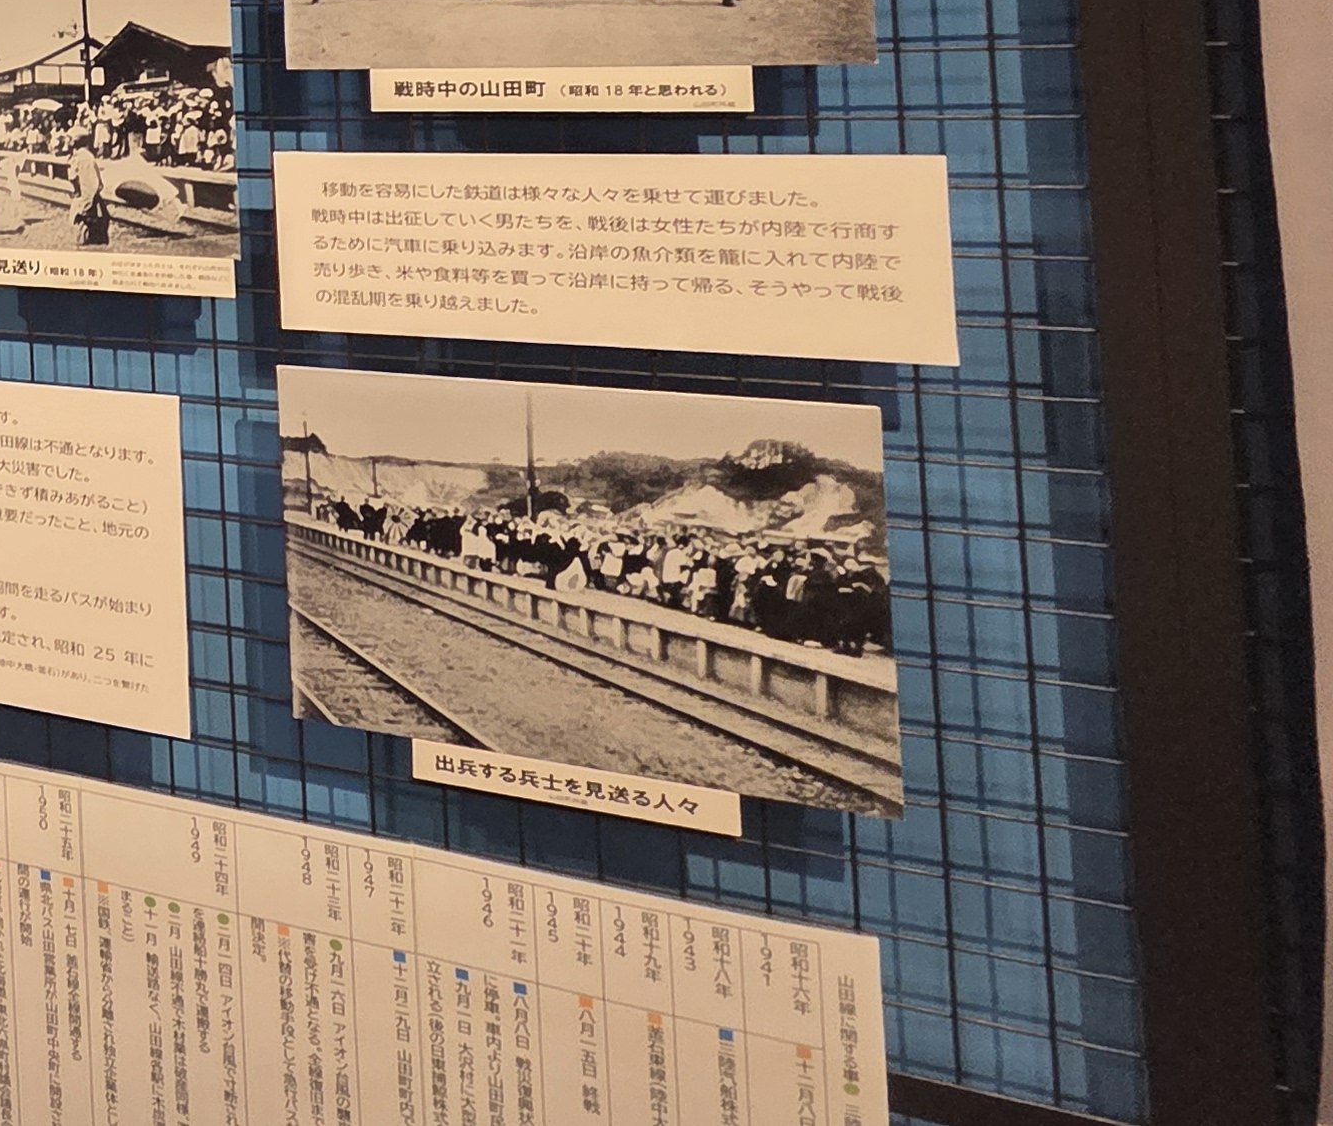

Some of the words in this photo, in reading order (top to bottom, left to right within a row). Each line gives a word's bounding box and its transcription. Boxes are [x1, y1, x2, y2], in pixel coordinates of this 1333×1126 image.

[393, 80, 546, 98] 戦時中の山田町
[321, 180, 823, 210] 移動を容易にした鉄道は様々な人々を乗せて運びました。
[311, 209, 900, 242] 戦時中は出征していく男たちを、戦後は女性たちが内陸で行商す
[316, 288, 540, 316] の混乱期を乗り越えました。
[38, 785, 49, 831] 1950
[435, 754, 700, 815] 出兵する兵士を見送る人々
[57, 789, 75, 862] 昭和二十五年
[190, 816, 202, 864] 1949
[212, 821, 230, 897] 昭和二十四年
[301, 836, 313, 887] 1948
[324, 844, 342, 922] 昭和二十三年
[363, 849, 376, 899] 1947
[387, 857, 407, 937] 昭和二十二年
[482, 877, 495, 928] 1946
[507, 882, 528, 965] 昭和二十一年
[546, 891, 560, 944] 1945
[572, 897, 593, 967] 昭和二十年
[613, 905, 628, 958] 1944
[641, 912, 662, 984] 昭和十九年
[682, 918, 697, 972] 1943
[712, 926, 733, 999] 昭和十八年
[759, 932, 774, 987] 1941
[789, 941, 813, 1016] 昭和十六年
